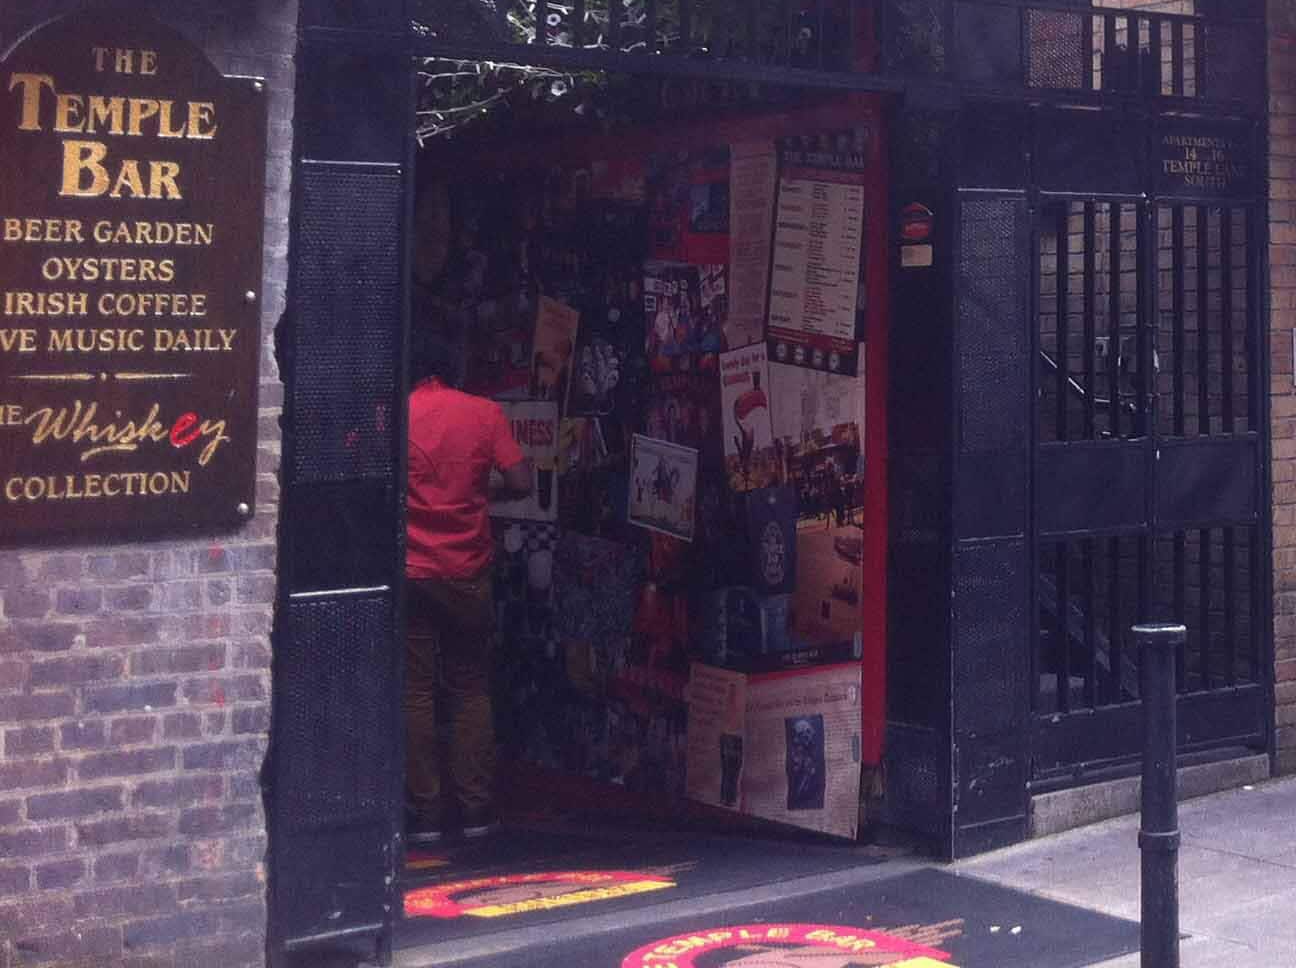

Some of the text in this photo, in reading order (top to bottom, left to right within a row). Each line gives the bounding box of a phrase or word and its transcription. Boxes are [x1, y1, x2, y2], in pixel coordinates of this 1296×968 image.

[92, 46, 159, 77] THE
[9, 72, 218, 140] TEMPLE
[58, 139, 183, 200] BAR
[3, 218, 215, 246] BEER GARDEN
[42, 257, 175, 282] OYSTERS
[4, 292, 208, 317] IRISH COFFEE
[48, 328, 144, 352] MUSIC
[153, 328, 237, 354] DAILY
[24, 398, 230, 466] Whiskey
[5, 470, 191, 502] COLLECTION
